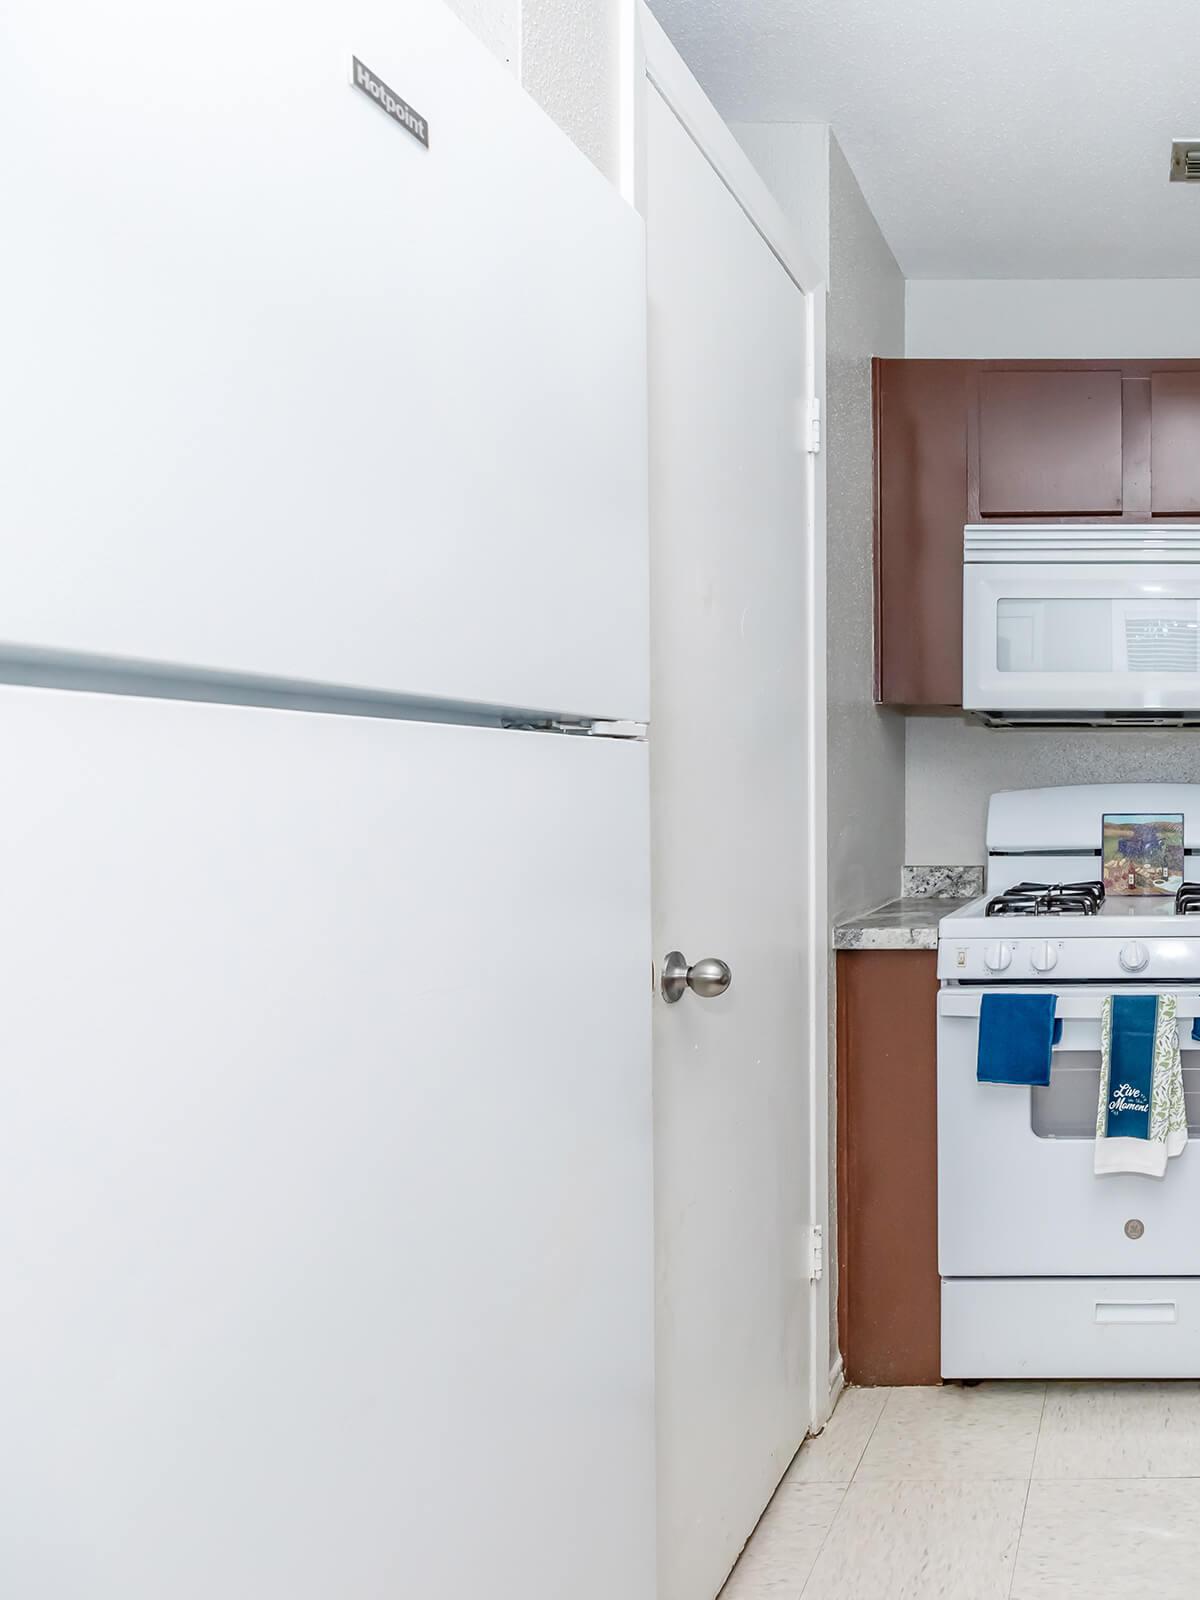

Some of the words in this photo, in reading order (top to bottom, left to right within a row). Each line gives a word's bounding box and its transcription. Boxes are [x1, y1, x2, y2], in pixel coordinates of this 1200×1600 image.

[356, 64, 425, 139] Hotpoint
[1113, 1083, 1141, 1098] Live
[1108, 1097, 1149, 1113] Moment
